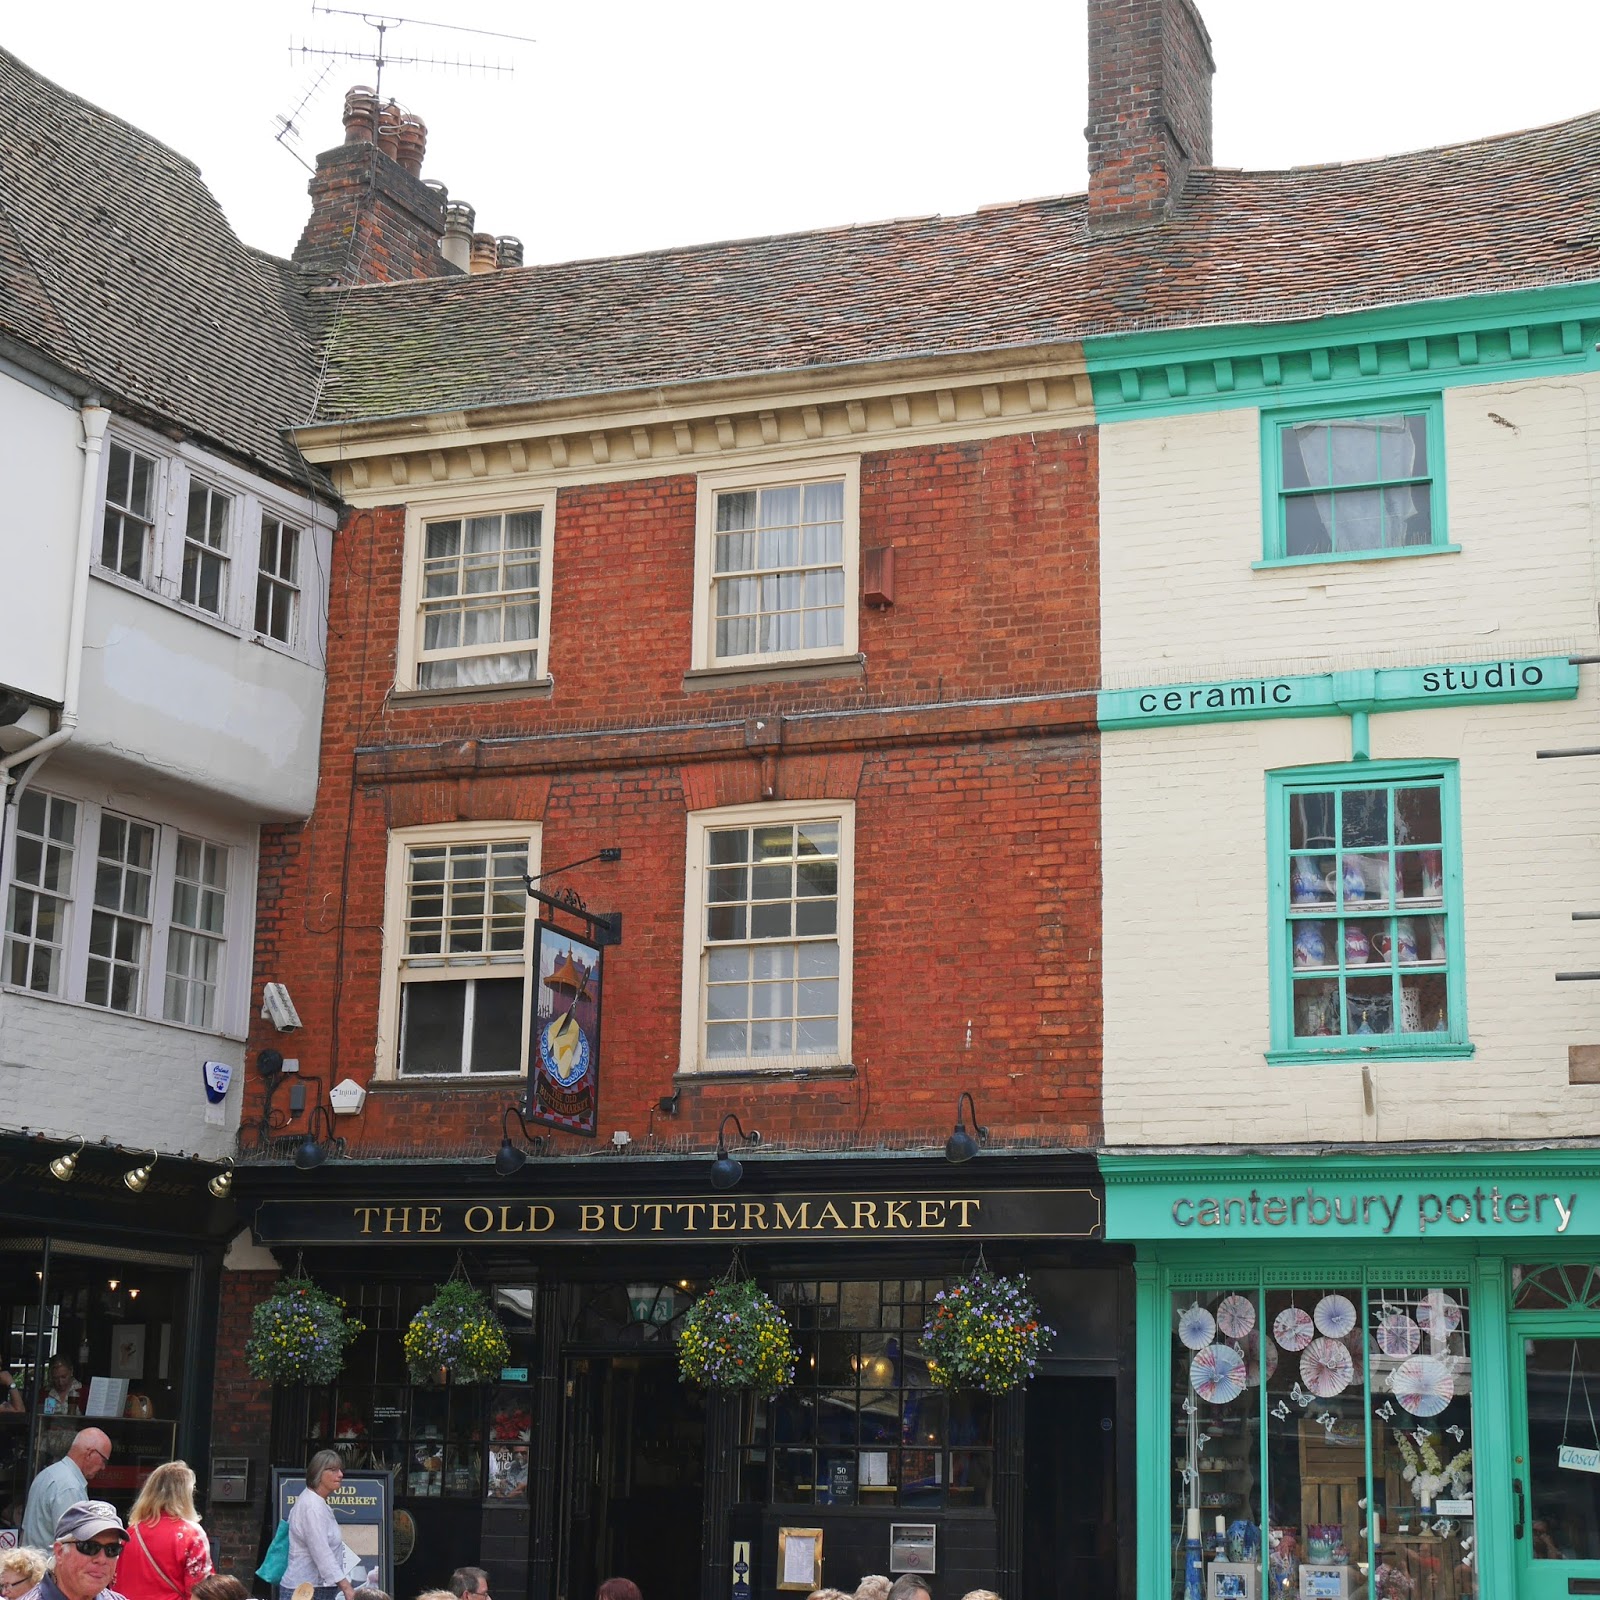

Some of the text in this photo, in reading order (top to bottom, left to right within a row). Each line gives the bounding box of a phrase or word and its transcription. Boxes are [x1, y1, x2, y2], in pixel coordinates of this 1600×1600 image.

[1139, 661, 1545, 713] ceramic studio
[552, 1088, 577, 1103] THE OLD
[354, 1199, 982, 1234] THE OLD BUTTERMARKET
[1172, 1186, 1577, 1234] canterbury pottery
[1562, 1450, 1598, 1466] Closed
[837, 1467, 846, 1475] 50
